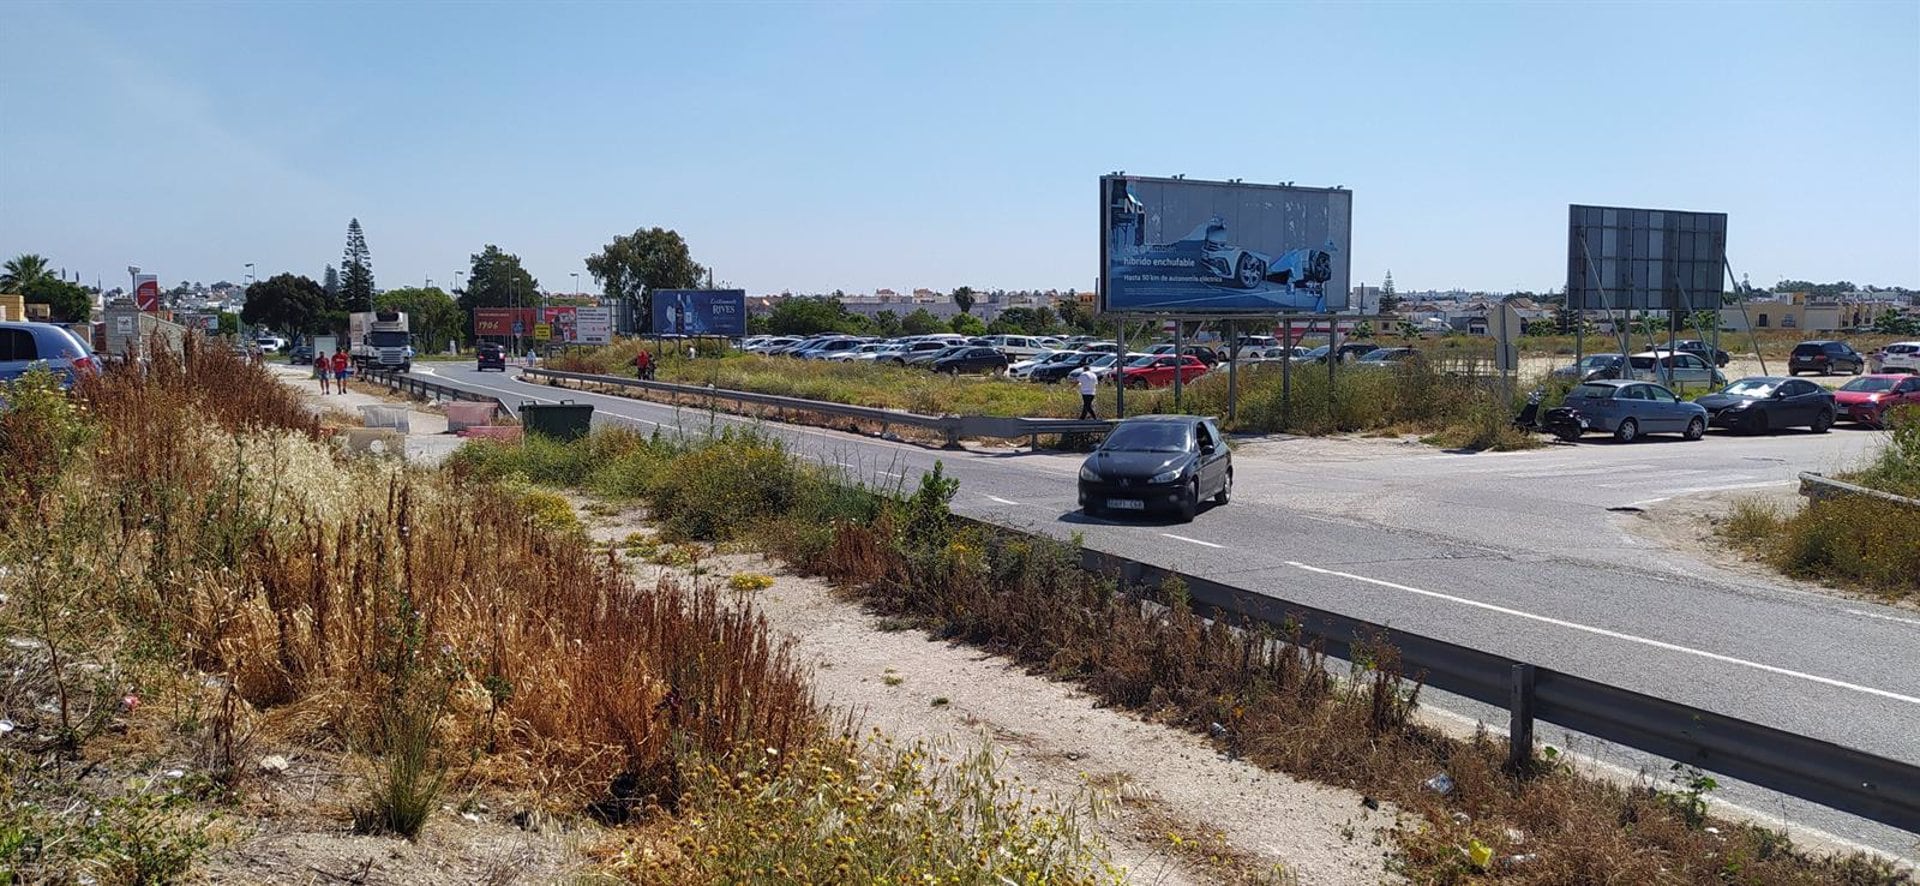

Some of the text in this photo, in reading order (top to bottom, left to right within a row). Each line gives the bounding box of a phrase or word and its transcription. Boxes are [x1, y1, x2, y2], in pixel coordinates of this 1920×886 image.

[1153, 258, 1195, 268] enchufable
[712, 304, 736, 315] RIVES
[479, 320, 499, 330] 1906
